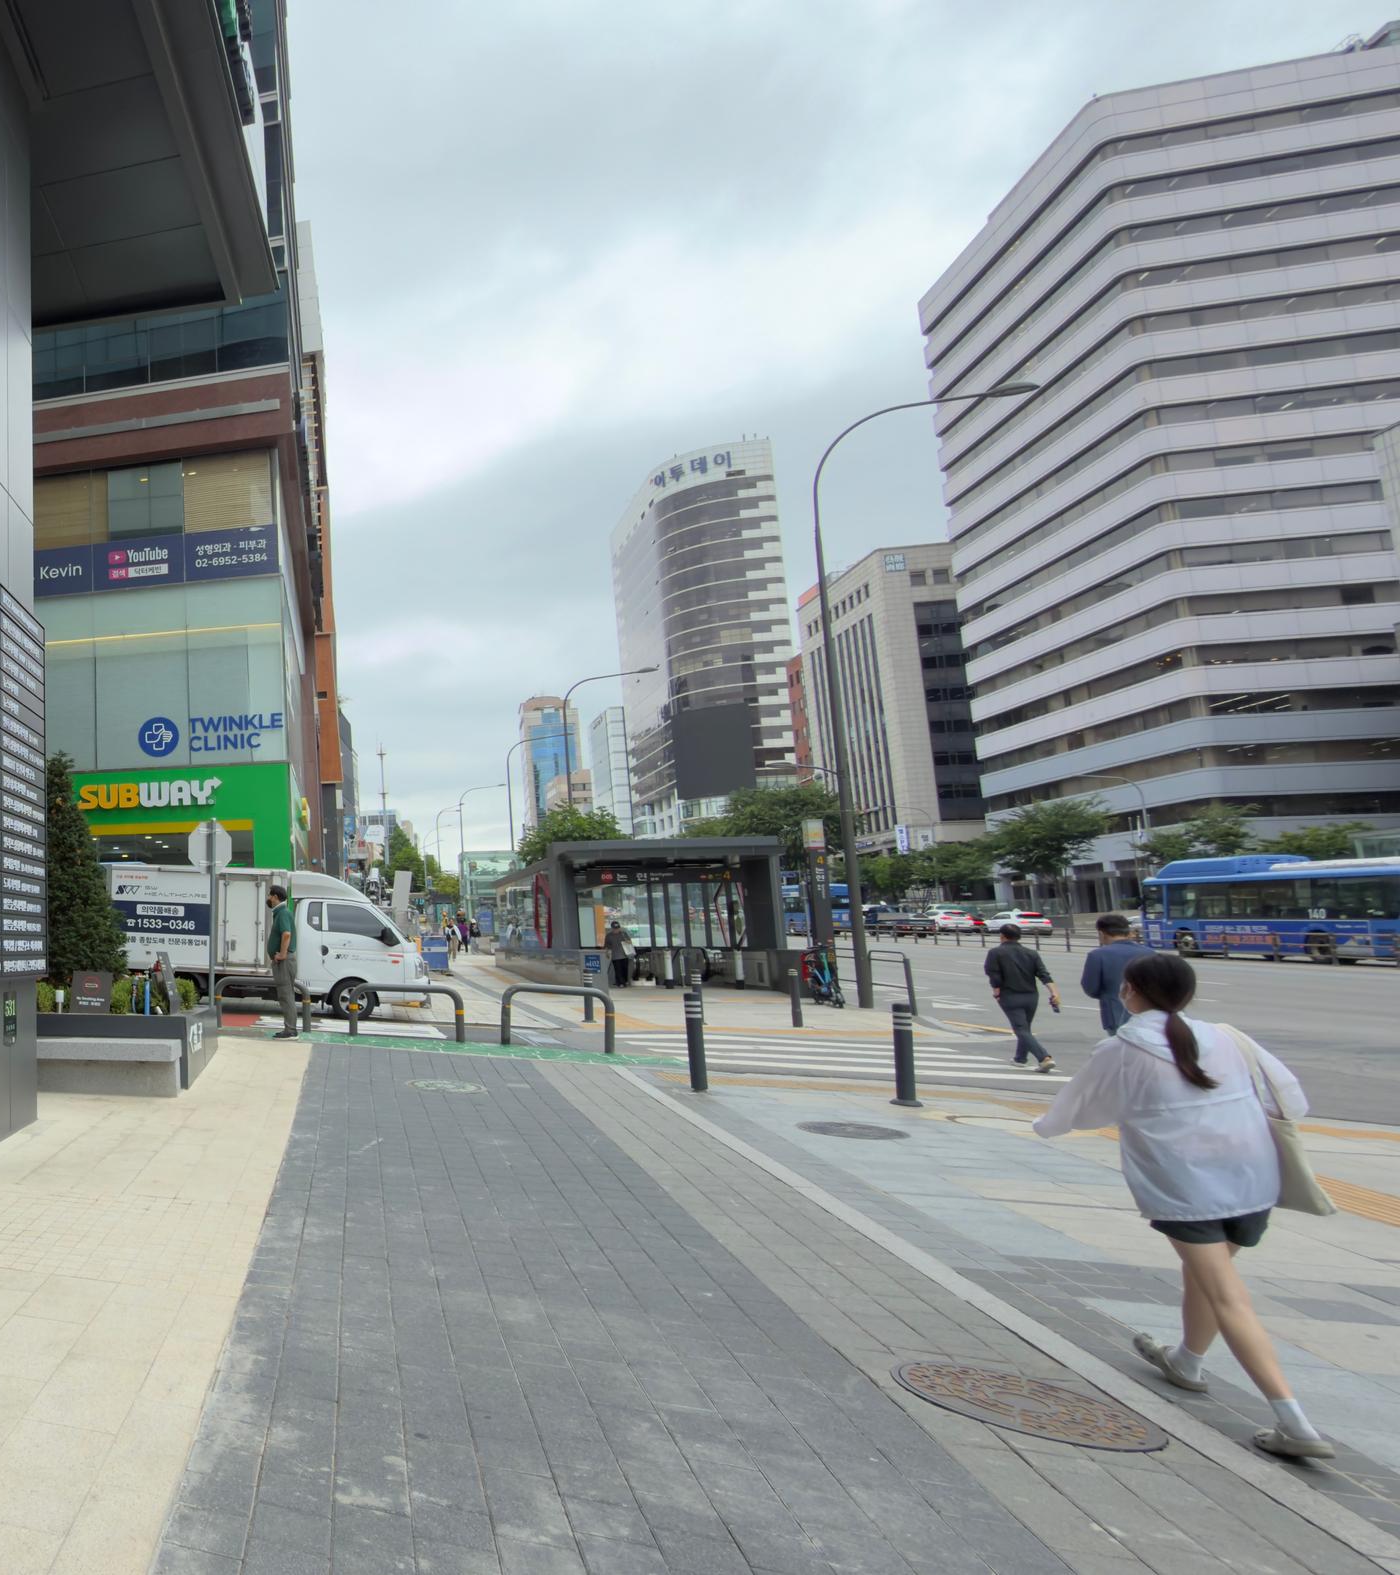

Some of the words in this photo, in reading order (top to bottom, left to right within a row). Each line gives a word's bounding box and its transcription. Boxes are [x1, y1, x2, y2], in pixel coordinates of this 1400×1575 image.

[653, 451, 732, 488] 이투데이
[127, 547, 169, 563] YouTube
[195, 543, 232, 556] 성형외과
[239, 538, 267, 551] 피부과
[195, 553, 268, 568] 02-6952-5384
[39, 563, 83, 580] Kevin
[189, 712, 284, 734] TWINKLE
[189, 732, 261, 752] CLINIC
[78, 776, 223, 810] SUBWAY
[141, 905, 179, 915] 의약품배송
[1307, 908, 1327, 920] 140
[137, 919, 196, 930] 1533-0346
[5, 999, 16, 1017] 531
